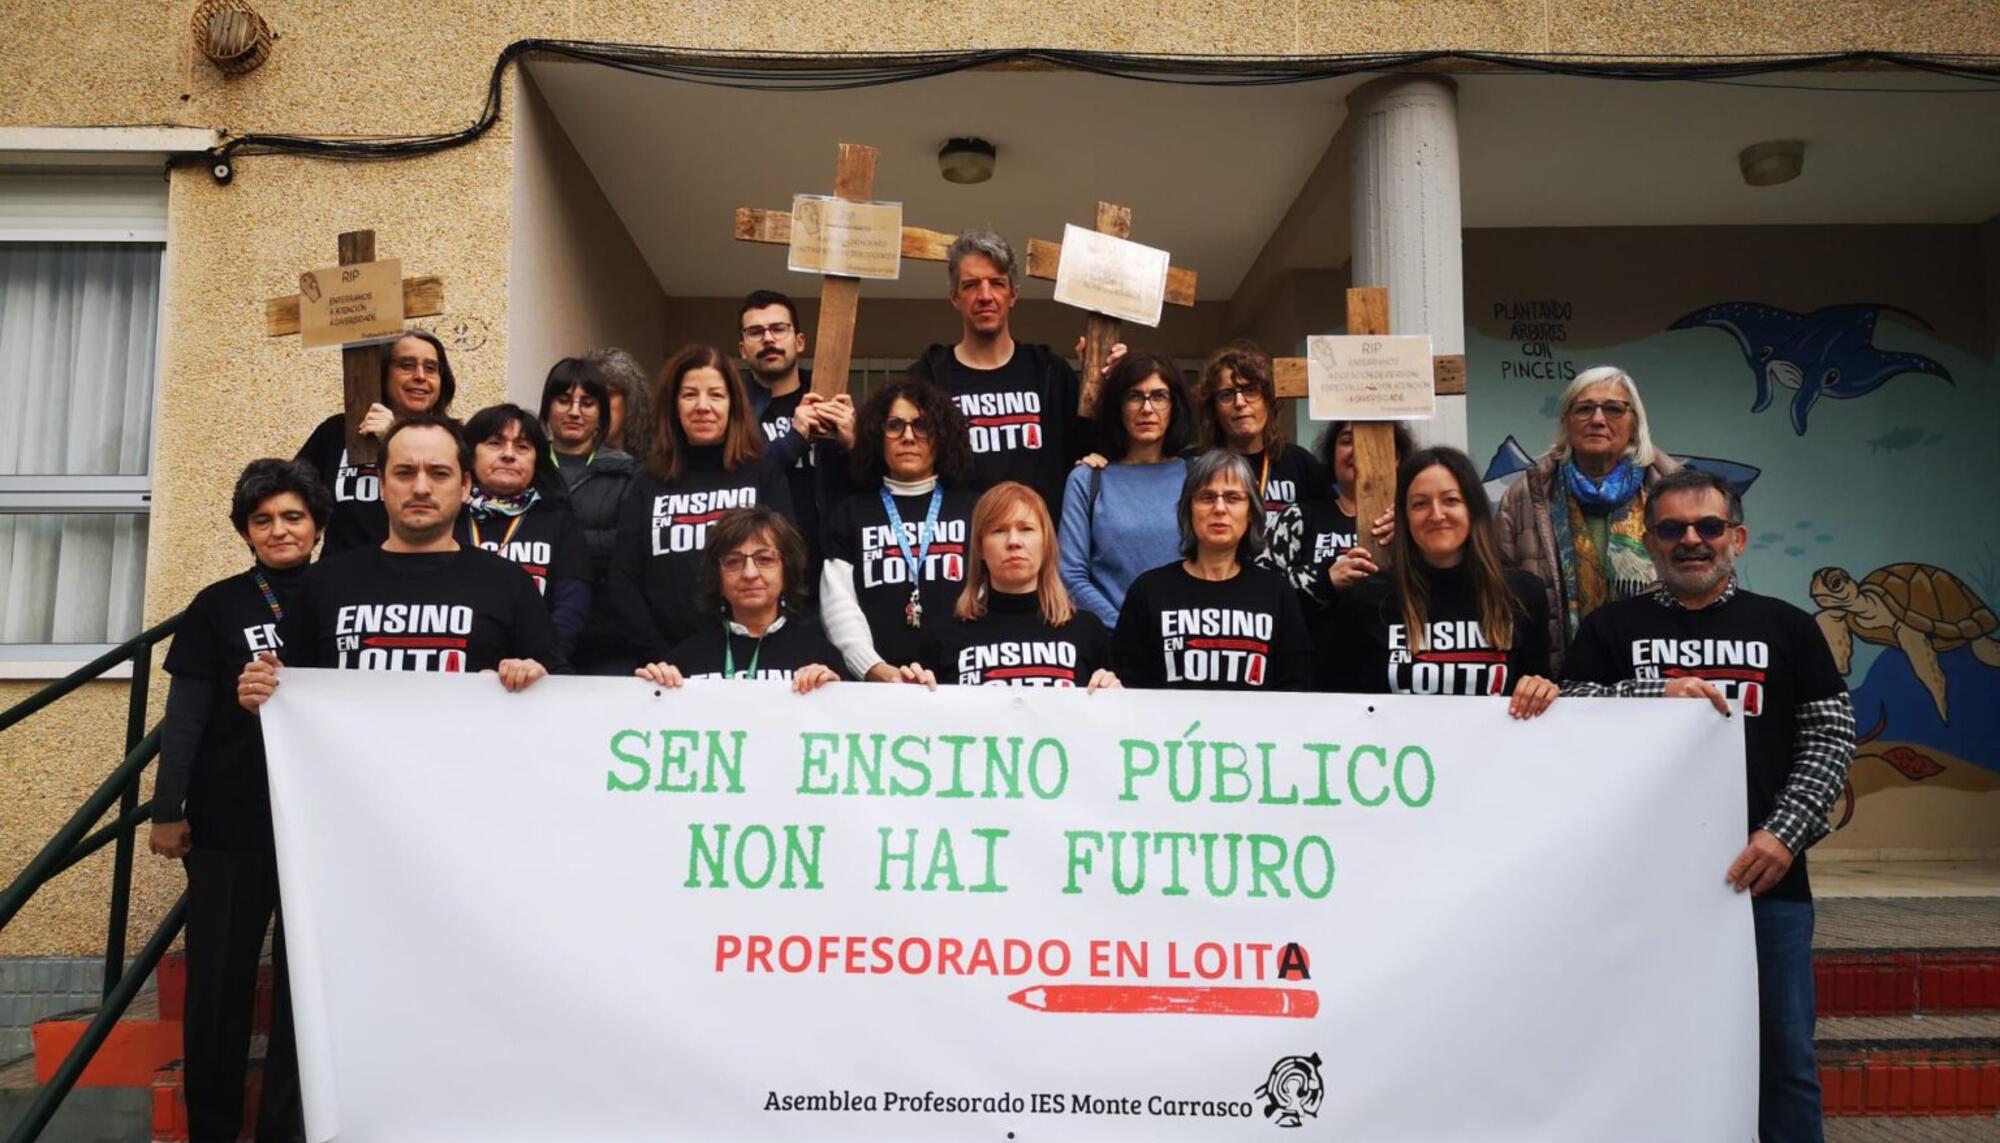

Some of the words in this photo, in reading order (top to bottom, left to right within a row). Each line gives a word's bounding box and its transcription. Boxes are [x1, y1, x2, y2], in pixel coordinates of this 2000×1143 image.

[341, 269, 361, 283] RIP
[1493, 301, 1573, 321] PLANTANDO
[1361, 341, 1383, 355] RIP
[1521, 341, 1552, 359] CON
[1501, 361, 1577, 381] PINCEIS
[335, 475, 385, 502] LO
[652, 487, 757, 517] ENSINO
[652, 516, 672, 529] EN
[652, 520, 719, 557] LOI
[863, 548, 883, 562] EN
[336, 604, 473, 636] ENSINO
[1161, 608, 1273, 641] ENSINO
[336, 634, 360, 651] EN
[1163, 636, 1184, 651] EN
[1632, 639, 1769, 669] ENSINO
[958, 640, 1077, 674] ENSINO
[1163, 649, 1267, 686] LOITA
[1389, 650, 1413, 664] EN
[959, 670, 981, 685] EN
[1387, 662, 1508, 696] LOITA
[1635, 665, 1660, 681] EN
[607, 728, 748, 794] SEN
[796, 732, 1069, 800] ENSINO
[1118, 720, 1436, 808] PÚBLICO
[683, 823, 826, 890] NON
[874, 827, 1011, 893] HAI
[1061, 830, 1336, 900] FUTURO
[715, 935, 1072, 977] PROFESORADO
[1089, 940, 1149, 979] EN
[1168, 942, 1312, 981] LOITA
[763, 1090, 878, 1113] Asemblea
[883, 1091, 1026, 1114] Profesorado
[1029, 1094, 1066, 1114] IES
[1071, 1095, 1143, 1116] Monte
[1148, 1096, 1254, 1118] Carrasco
